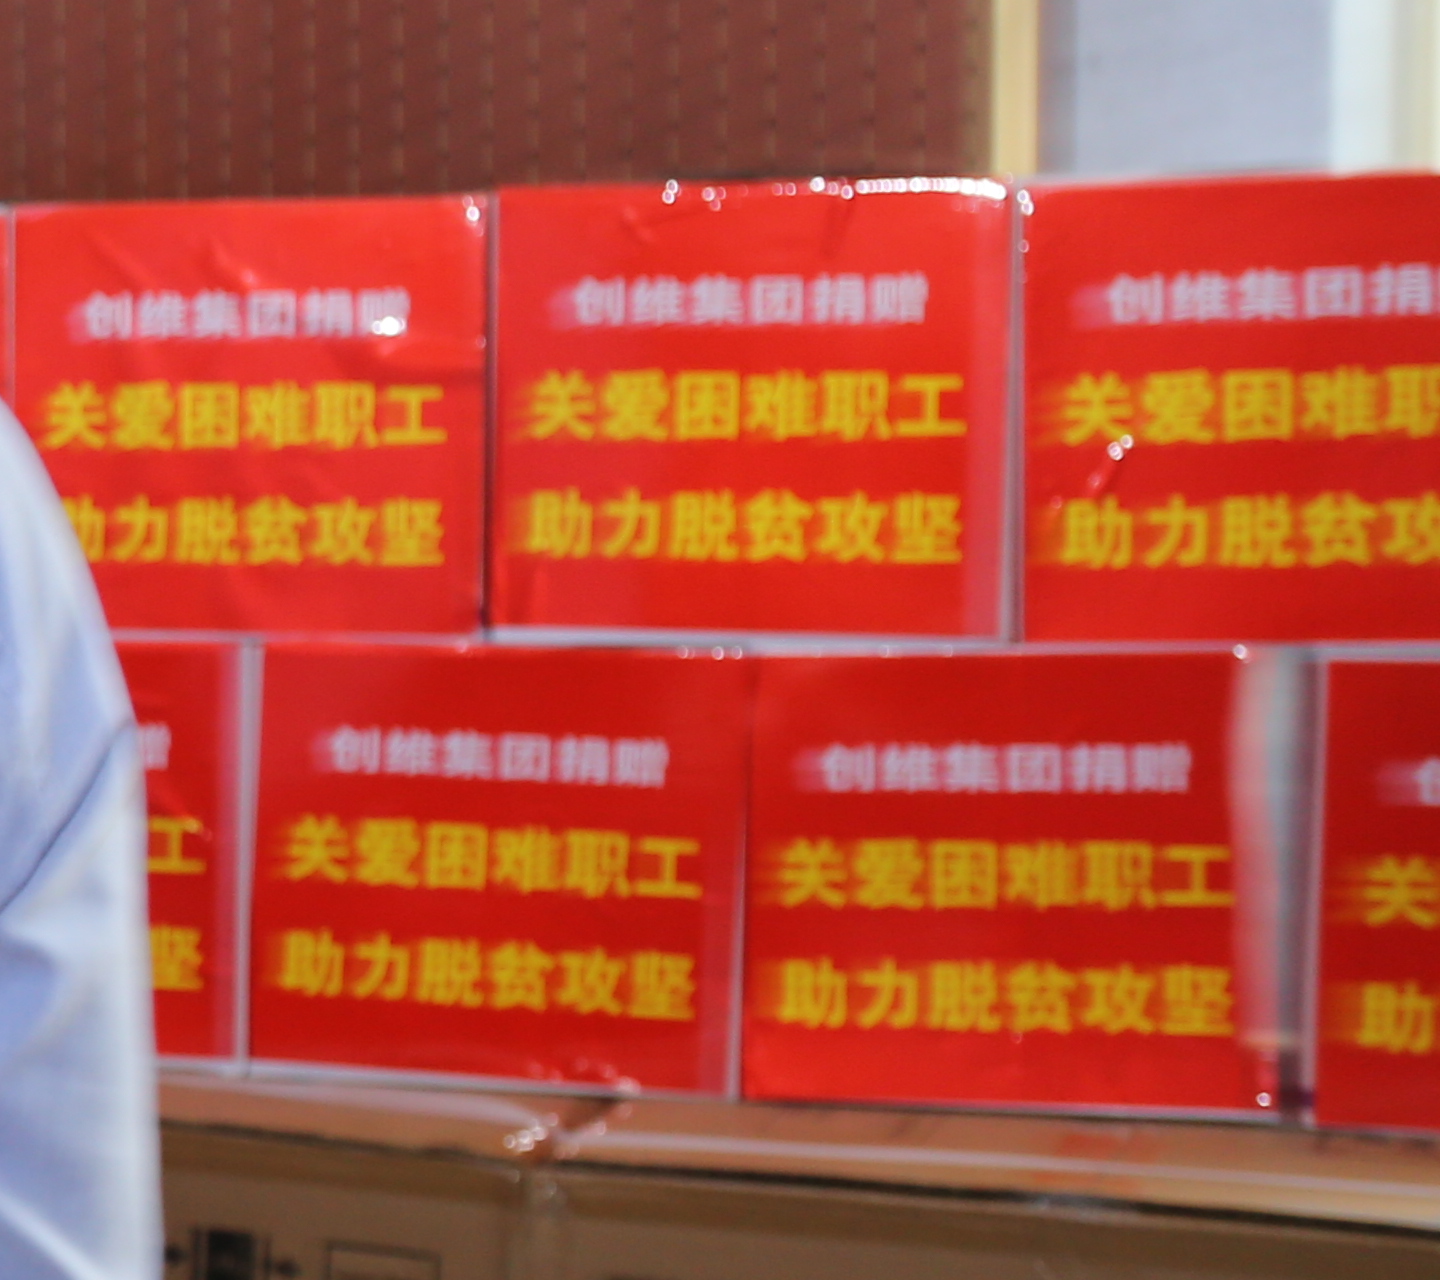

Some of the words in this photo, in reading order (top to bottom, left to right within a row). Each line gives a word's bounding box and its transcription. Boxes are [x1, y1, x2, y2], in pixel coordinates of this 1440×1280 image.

[82, 287, 411, 339] 创维集团捐赠
[572, 270, 929, 327] 创维集团捐赠
[44, 380, 448, 450] 关爱困难职工
[526, 368, 968, 442] 关爱困难职工
[522, 486, 964, 566] 助力脱贫攻坚
[330, 724, 670, 789] 创维集团捐赠
[820, 740, 1193, 795] 创维集团捐赠
[284, 812, 703, 900] 关爱困难职工
[777, 836, 1236, 911] 关爱困难职工
[278, 925, 696, 1021] 助力脱贫攻坚
[777, 956, 1235, 1037] 助力脱贫攻坚
